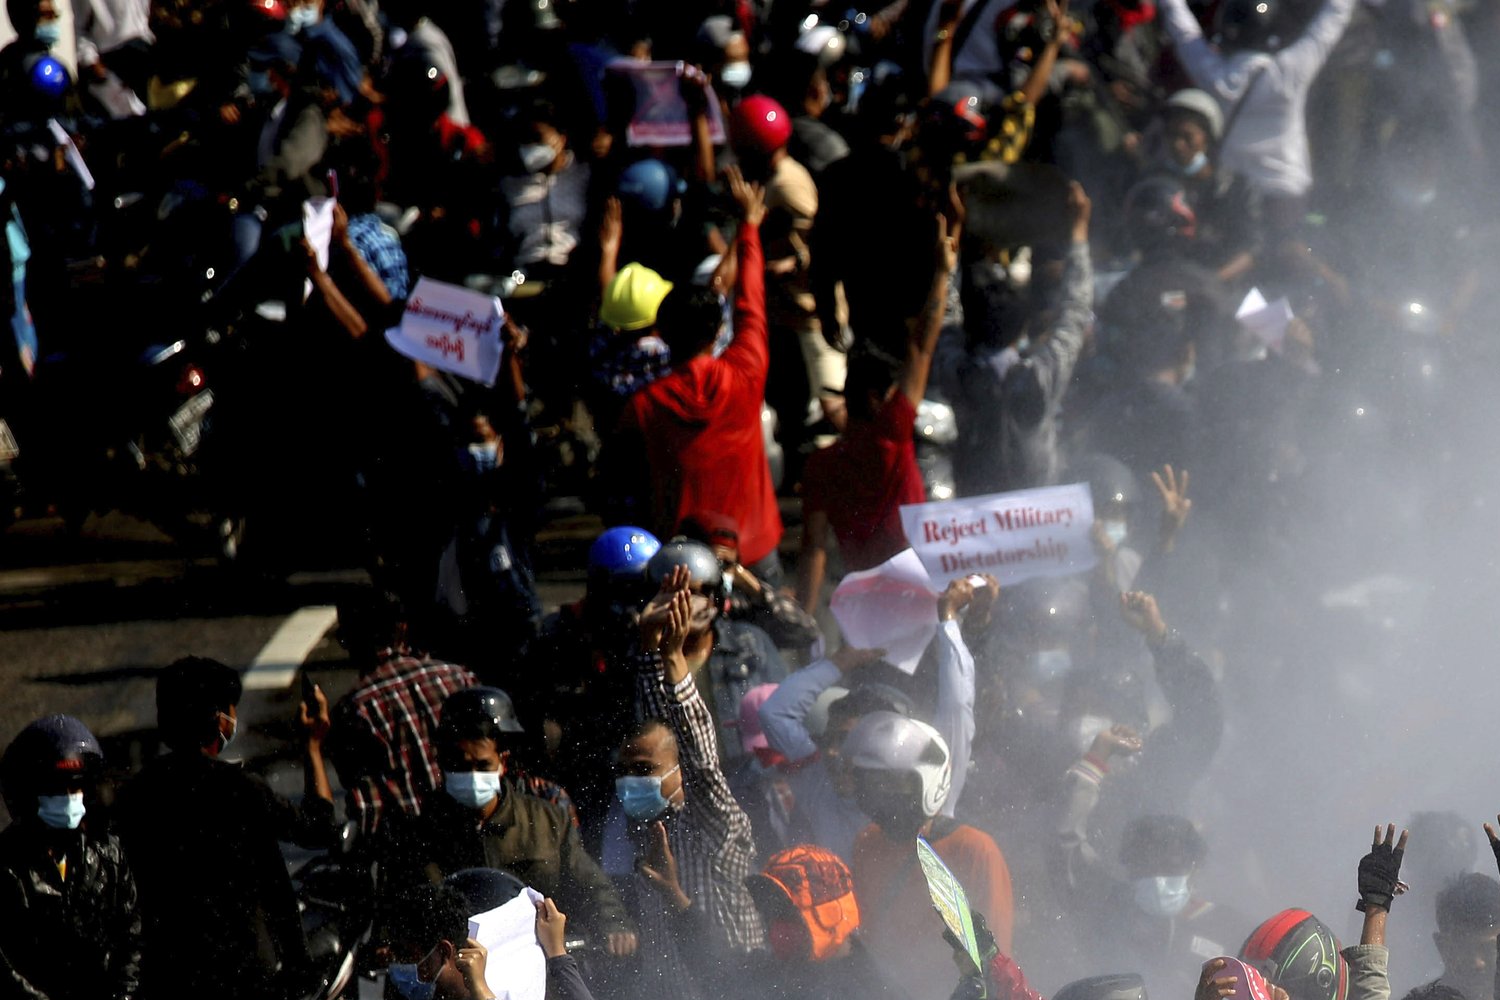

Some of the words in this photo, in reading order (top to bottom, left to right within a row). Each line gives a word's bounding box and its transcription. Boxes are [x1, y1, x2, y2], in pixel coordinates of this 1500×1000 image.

[923, 519, 988, 546] Reject
[993, 506, 1074, 533] Military
[939, 537, 1069, 574] Dictatorship
